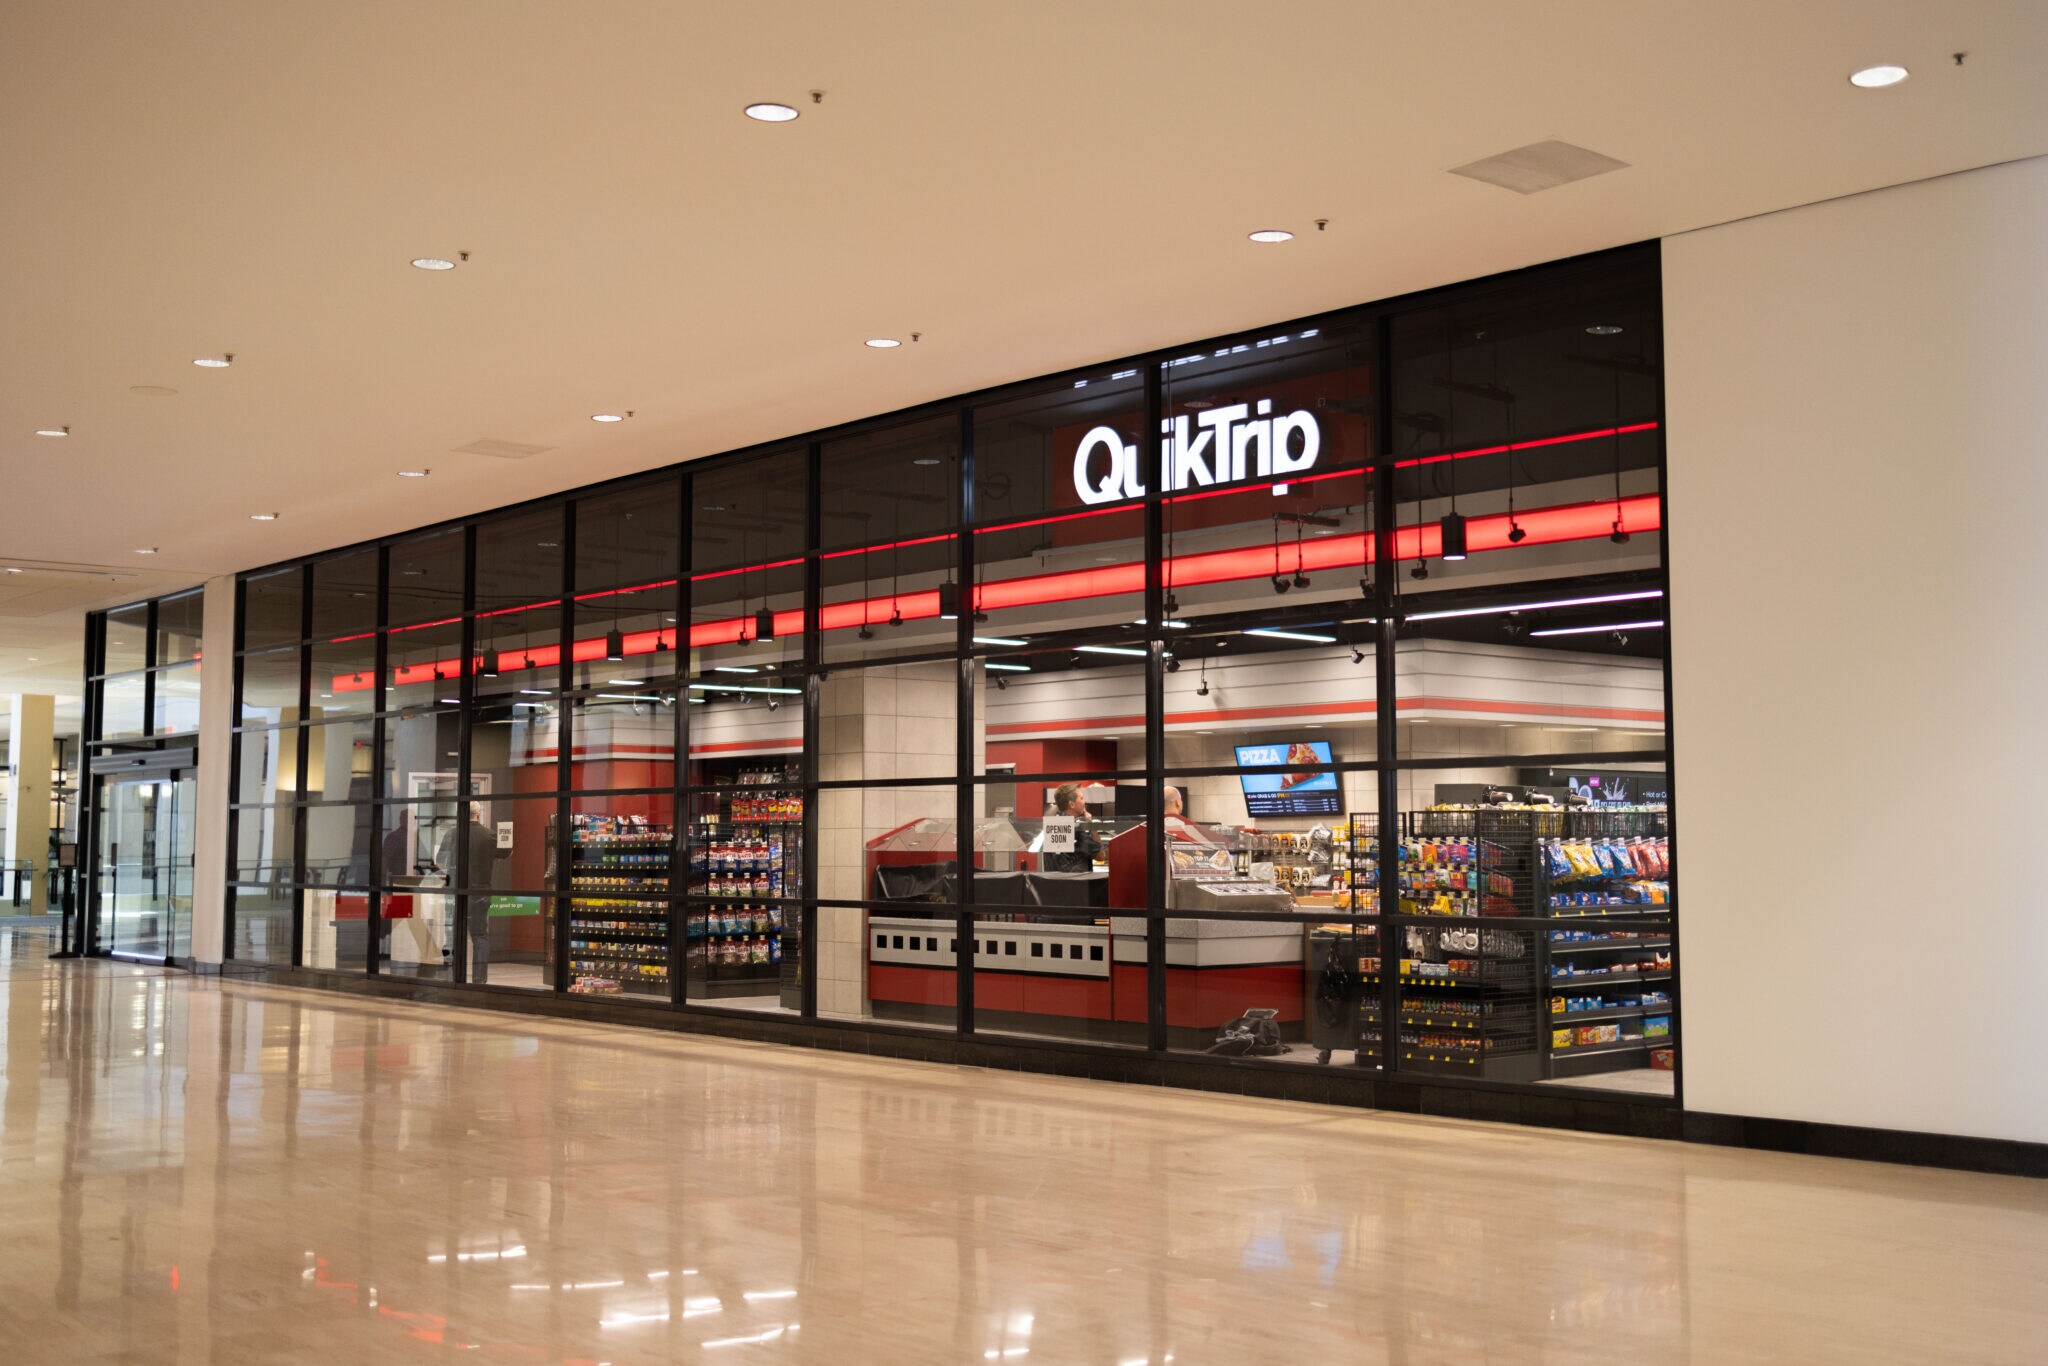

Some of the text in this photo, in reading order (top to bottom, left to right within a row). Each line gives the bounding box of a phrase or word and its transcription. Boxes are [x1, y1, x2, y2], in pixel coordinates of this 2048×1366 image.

[1073, 398, 1321, 505] QuikTrip
[1239, 749, 1281, 765] PIZZA
[1046, 825, 1072, 833] OPENING
[1051, 834, 1066, 843] SOON
